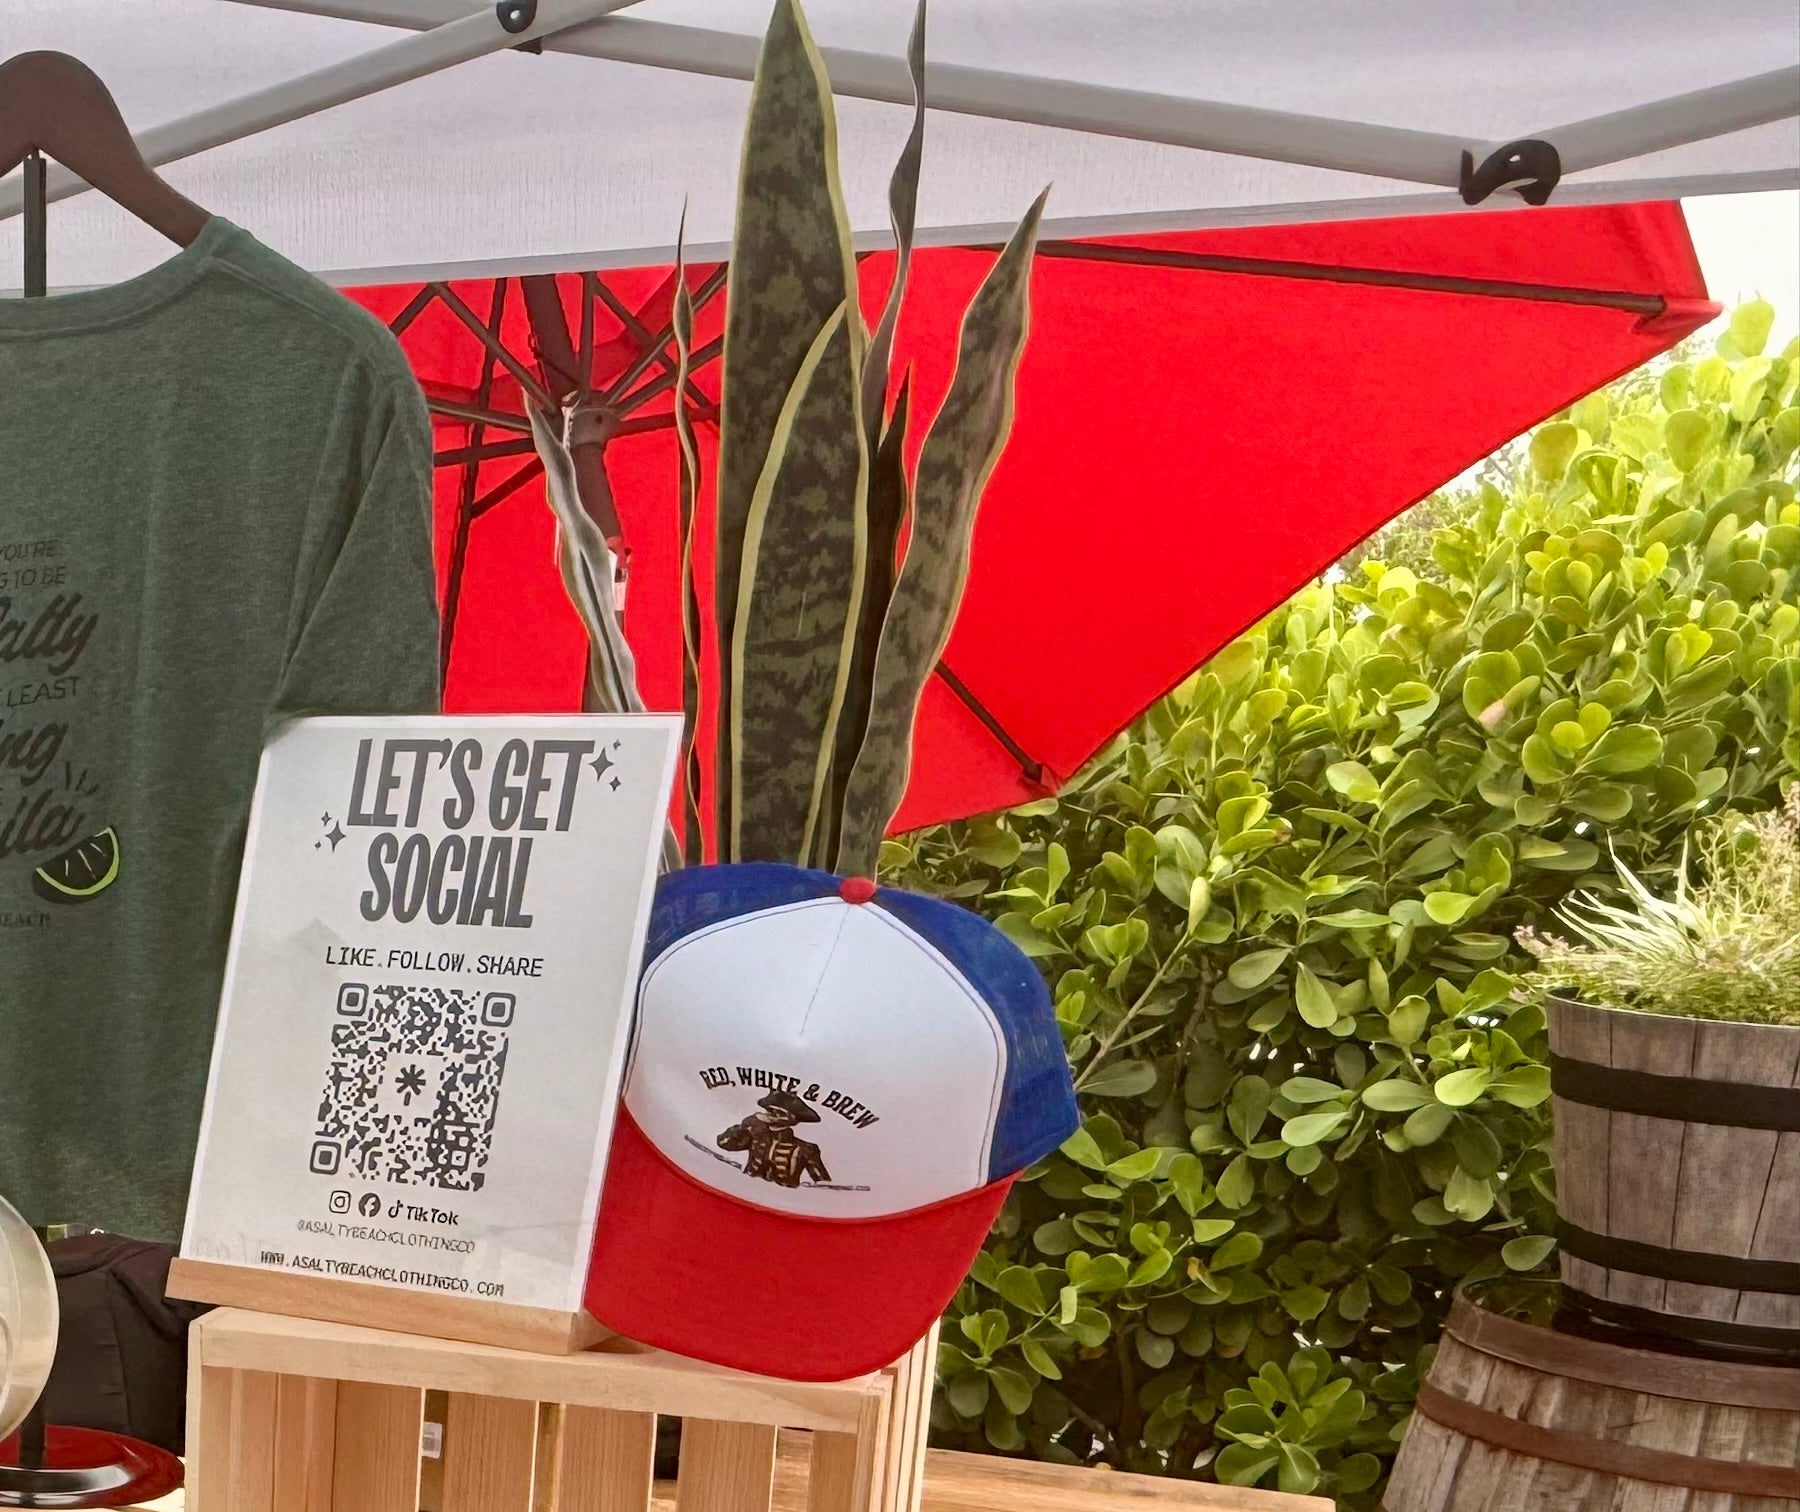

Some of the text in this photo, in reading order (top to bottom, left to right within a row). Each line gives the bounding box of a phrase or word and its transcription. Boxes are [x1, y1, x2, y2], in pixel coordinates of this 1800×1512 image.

[13, 568, 35, 589] TO
[38, 565, 68, 586] BE
[6, 676, 80, 710] LEAST
[346, 738, 596, 832] LET'S GET
[359, 832, 535, 929] SOCIAL
[699, 1066, 880, 1129] RED, WHITE & BREW
